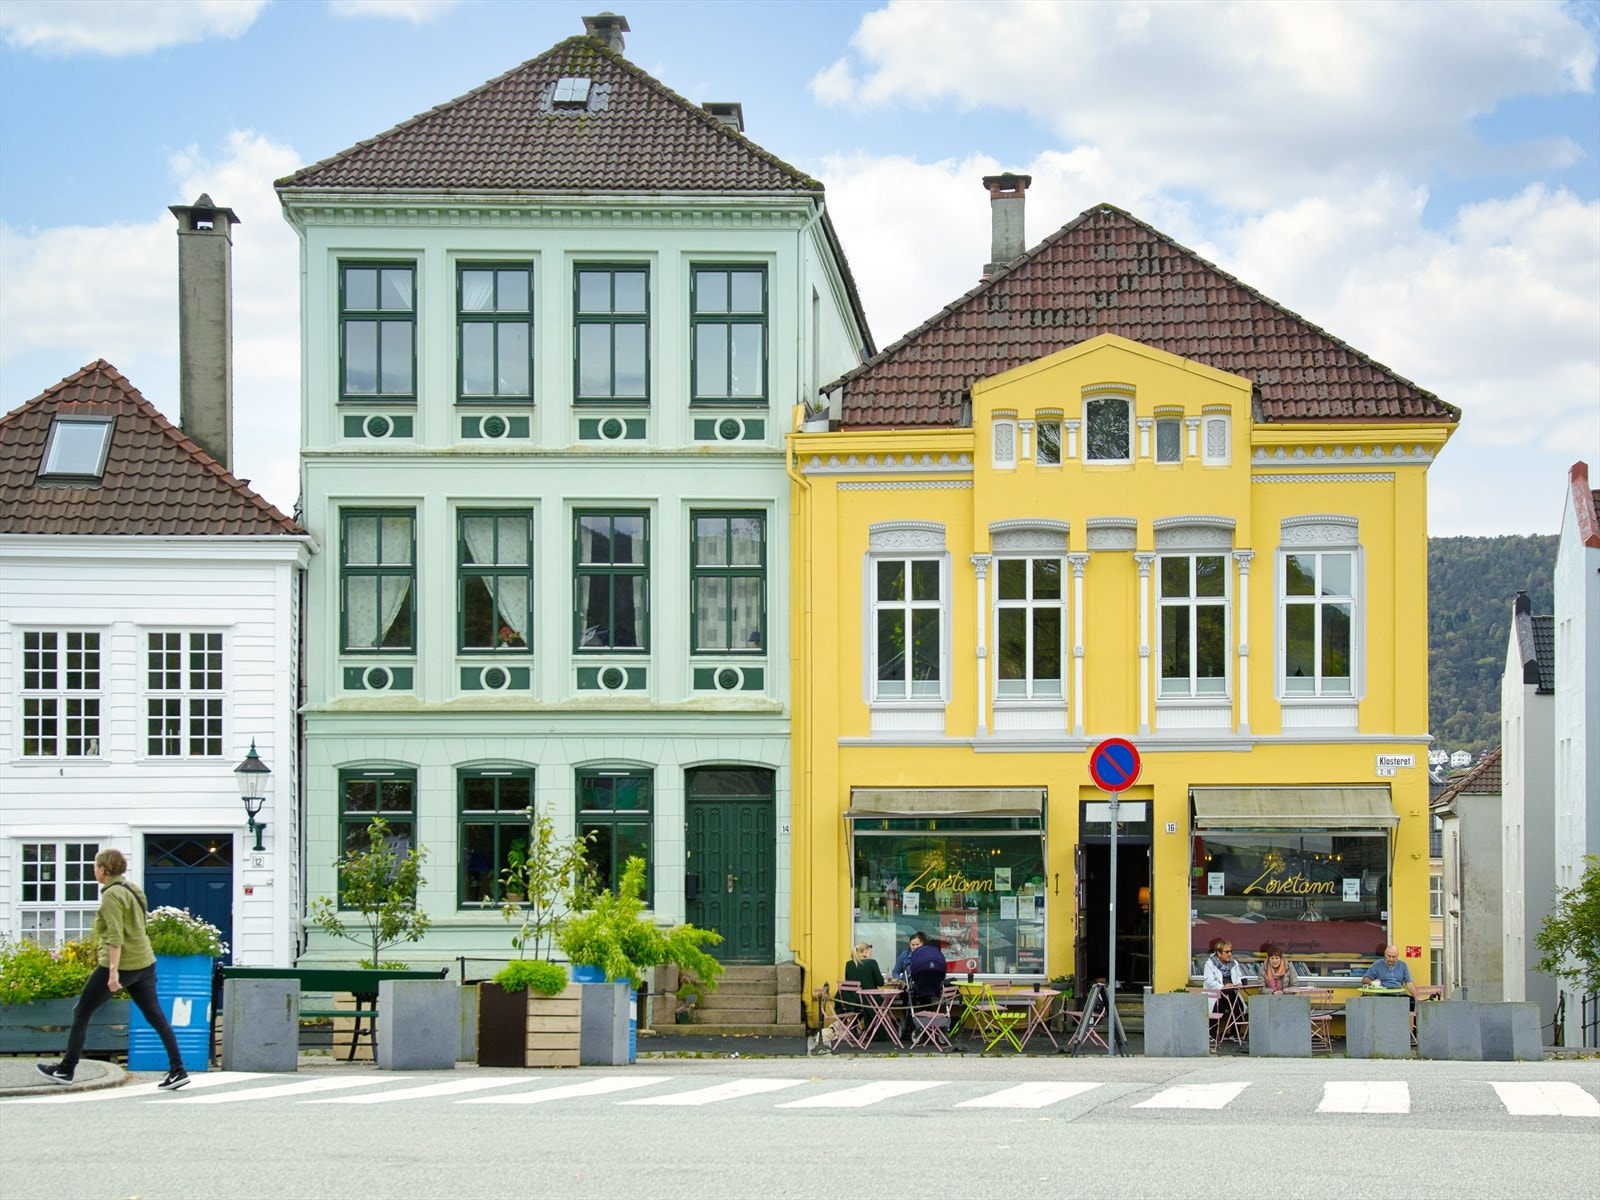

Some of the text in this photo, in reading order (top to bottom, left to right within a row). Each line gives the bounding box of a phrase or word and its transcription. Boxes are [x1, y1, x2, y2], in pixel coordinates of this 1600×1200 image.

[1379, 757, 1411, 766] Klosteret
[782, 825, 789, 833] 14
[1168, 824, 1175, 832] 16
[255, 858, 262, 866] 12
[1243, 862, 1336, 894] Løvetann
[1265, 899, 1315, 909] KAFFEBAR
